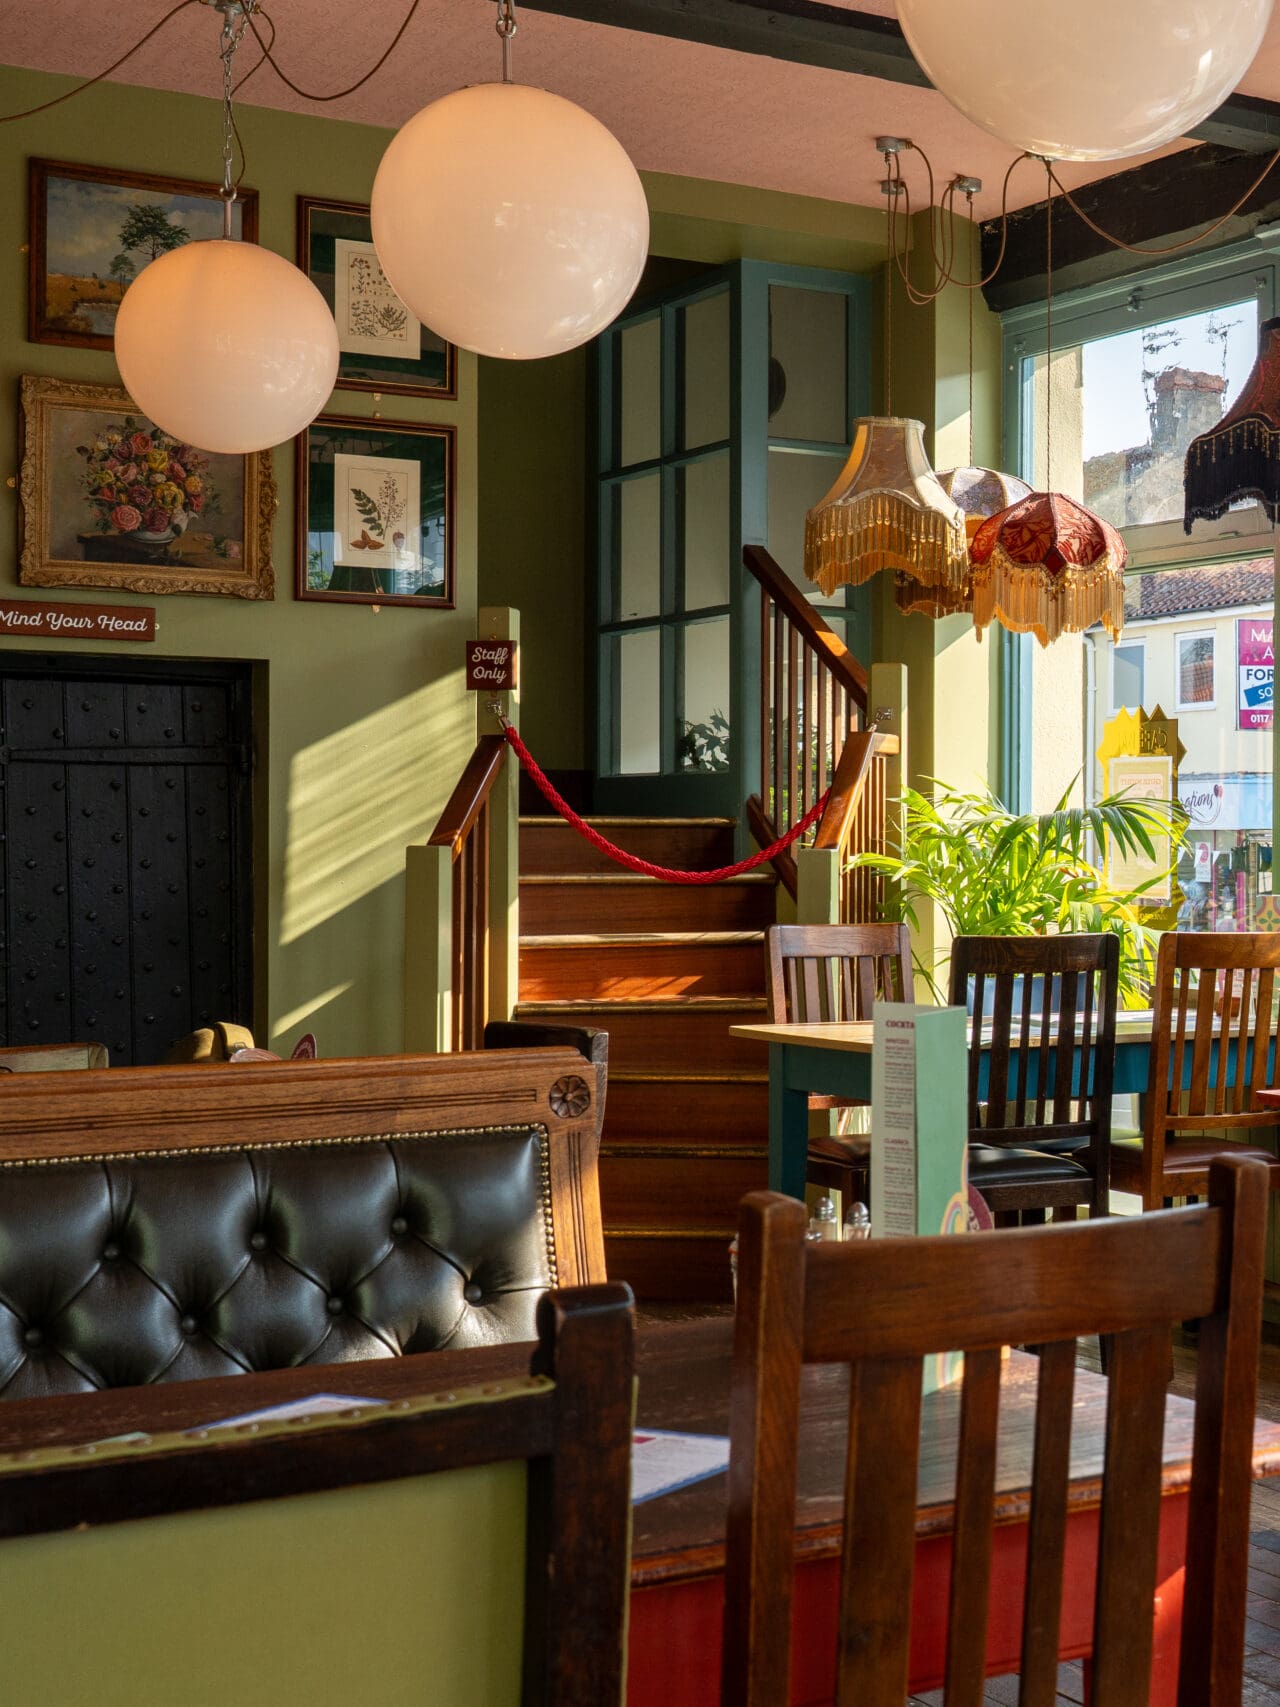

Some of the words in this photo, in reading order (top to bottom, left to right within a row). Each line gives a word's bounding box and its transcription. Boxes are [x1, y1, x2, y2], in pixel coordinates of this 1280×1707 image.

[0, 610, 43, 627] Mind
[46, 612, 94, 631] Your
[97, 615, 148, 632] Head
[471, 646, 509, 665] Staff
[473, 666, 507, 684] Only
[1246, 668, 1274, 681] FOR
[1250, 714, 1270, 724] 0117
